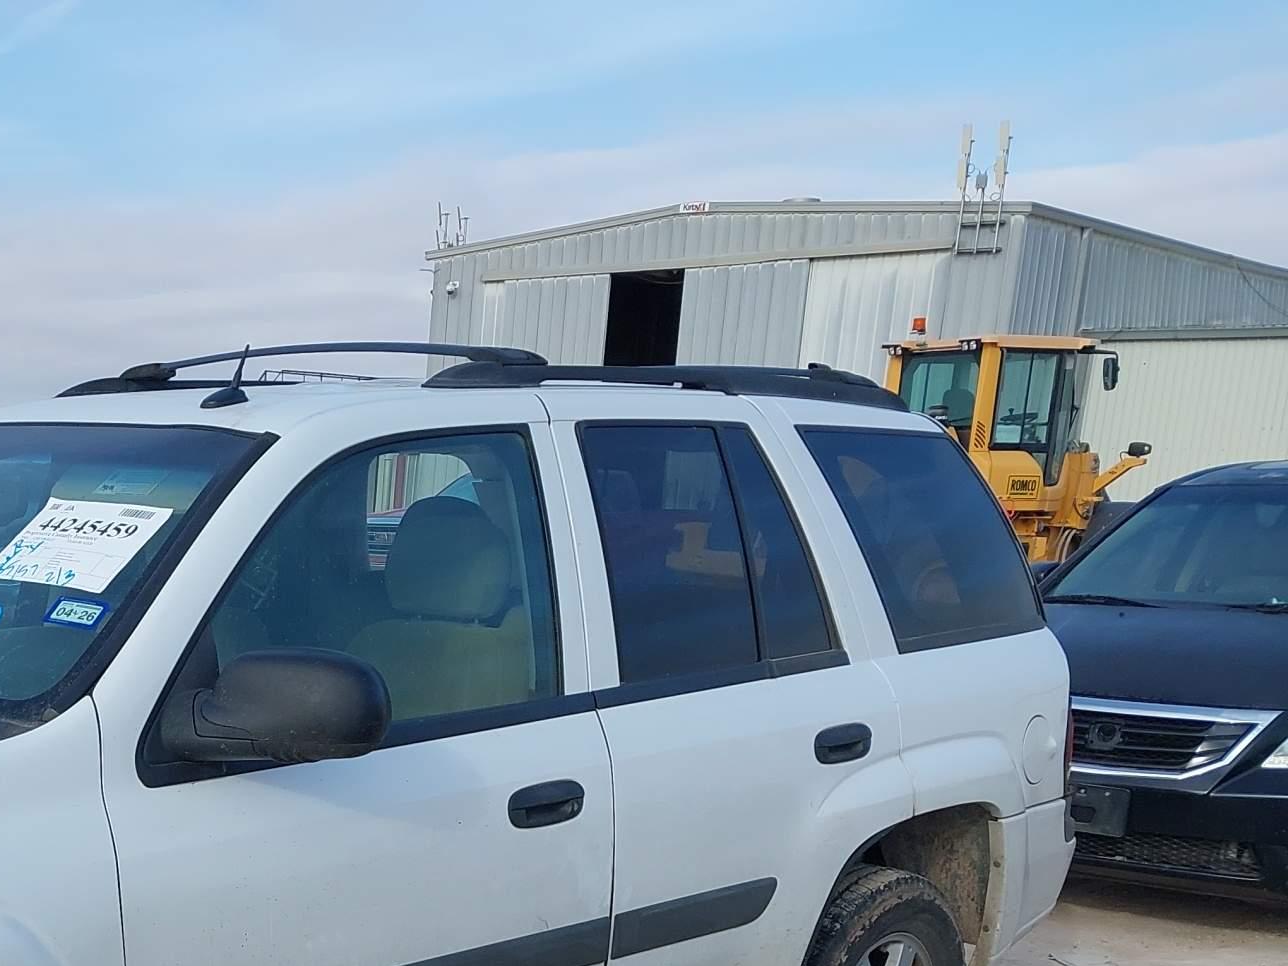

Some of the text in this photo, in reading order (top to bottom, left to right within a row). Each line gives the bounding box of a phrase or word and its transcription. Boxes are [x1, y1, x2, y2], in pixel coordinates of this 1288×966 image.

[1010, 479, 1037, 491] ROMCO
[40, 516, 139, 539] 44245459
[56, 607, 97, 622] 04 26
